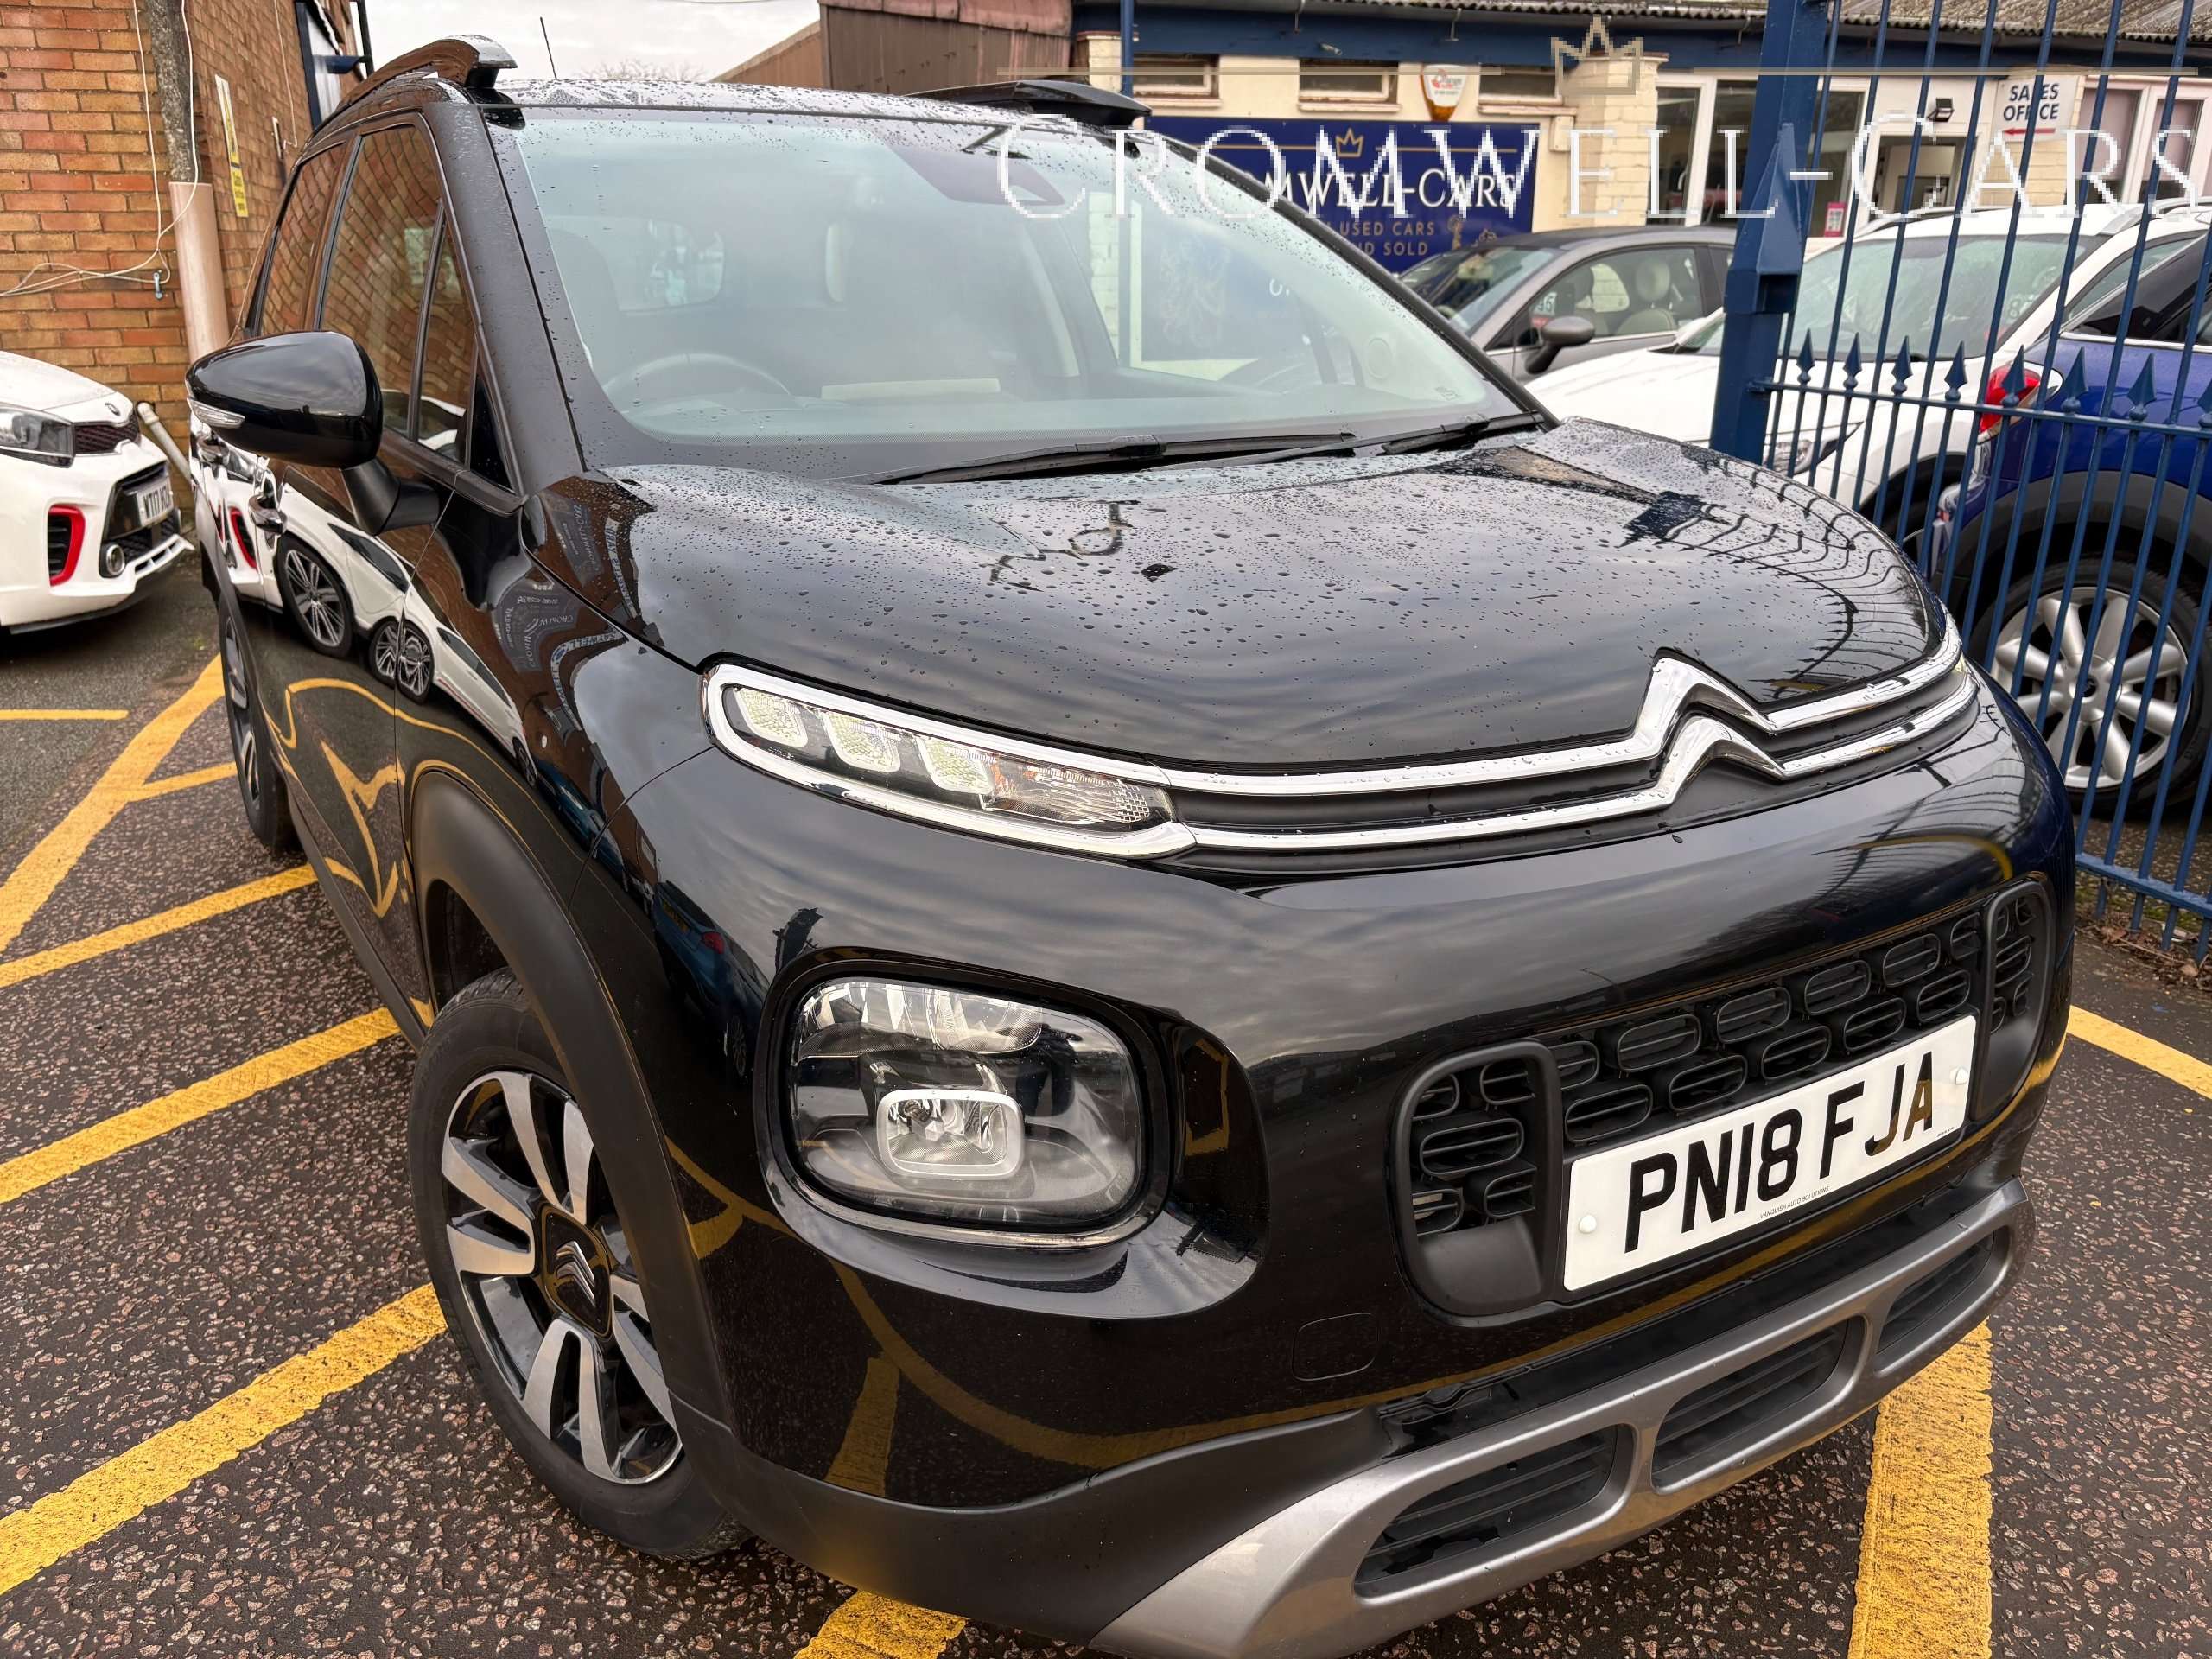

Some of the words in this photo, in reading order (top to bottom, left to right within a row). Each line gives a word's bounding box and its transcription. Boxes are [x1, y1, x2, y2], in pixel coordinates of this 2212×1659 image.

[2009, 83, 2059, 101] SAES
[1339, 221, 1383, 237] USED
[1392, 221, 1435, 237] CARS
[1384, 242, 1428, 257] SOLD
[1624, 1108, 1802, 1254] PN18
[1819, 1051, 1934, 1180] FJA
[1760, 1204, 1786, 1219] VANQUISH
[1787, 1198, 1802, 1208] AUTO
[1802, 1185, 1830, 1202] SOLUTIONS
